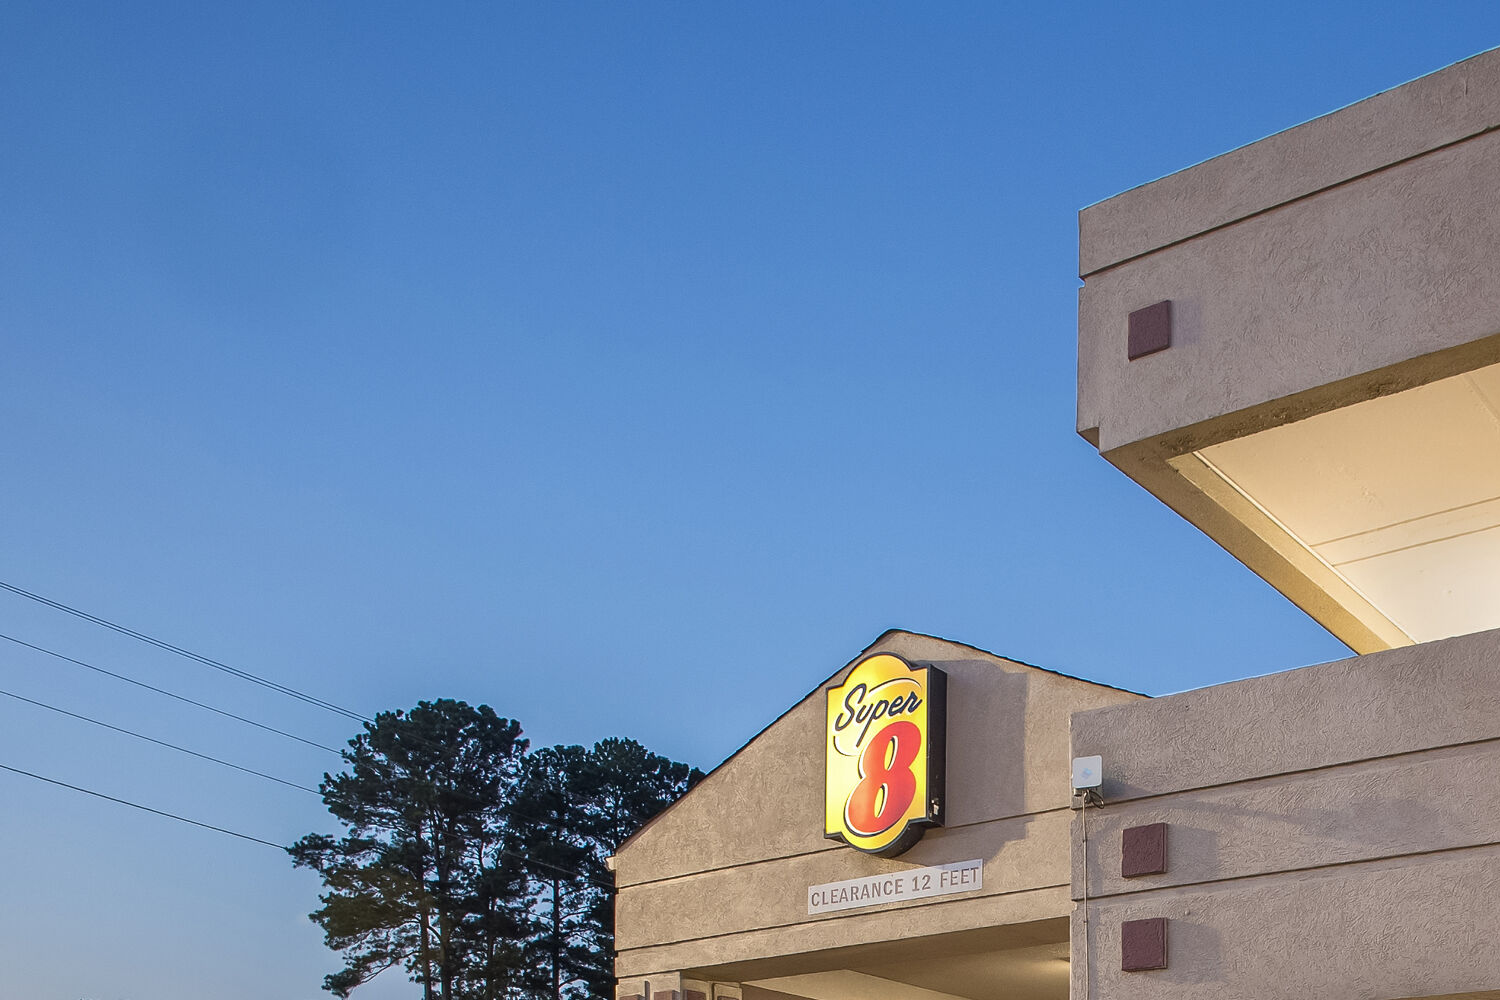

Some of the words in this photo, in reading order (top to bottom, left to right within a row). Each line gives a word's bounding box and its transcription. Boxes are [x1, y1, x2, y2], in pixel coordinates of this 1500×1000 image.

[834, 683, 923, 748] Super
[844, 720, 922, 837] 8
[811, 878, 904, 907] CLEARANCE
[911, 874, 931, 892] 12
[940, 866, 979, 888] FEET
